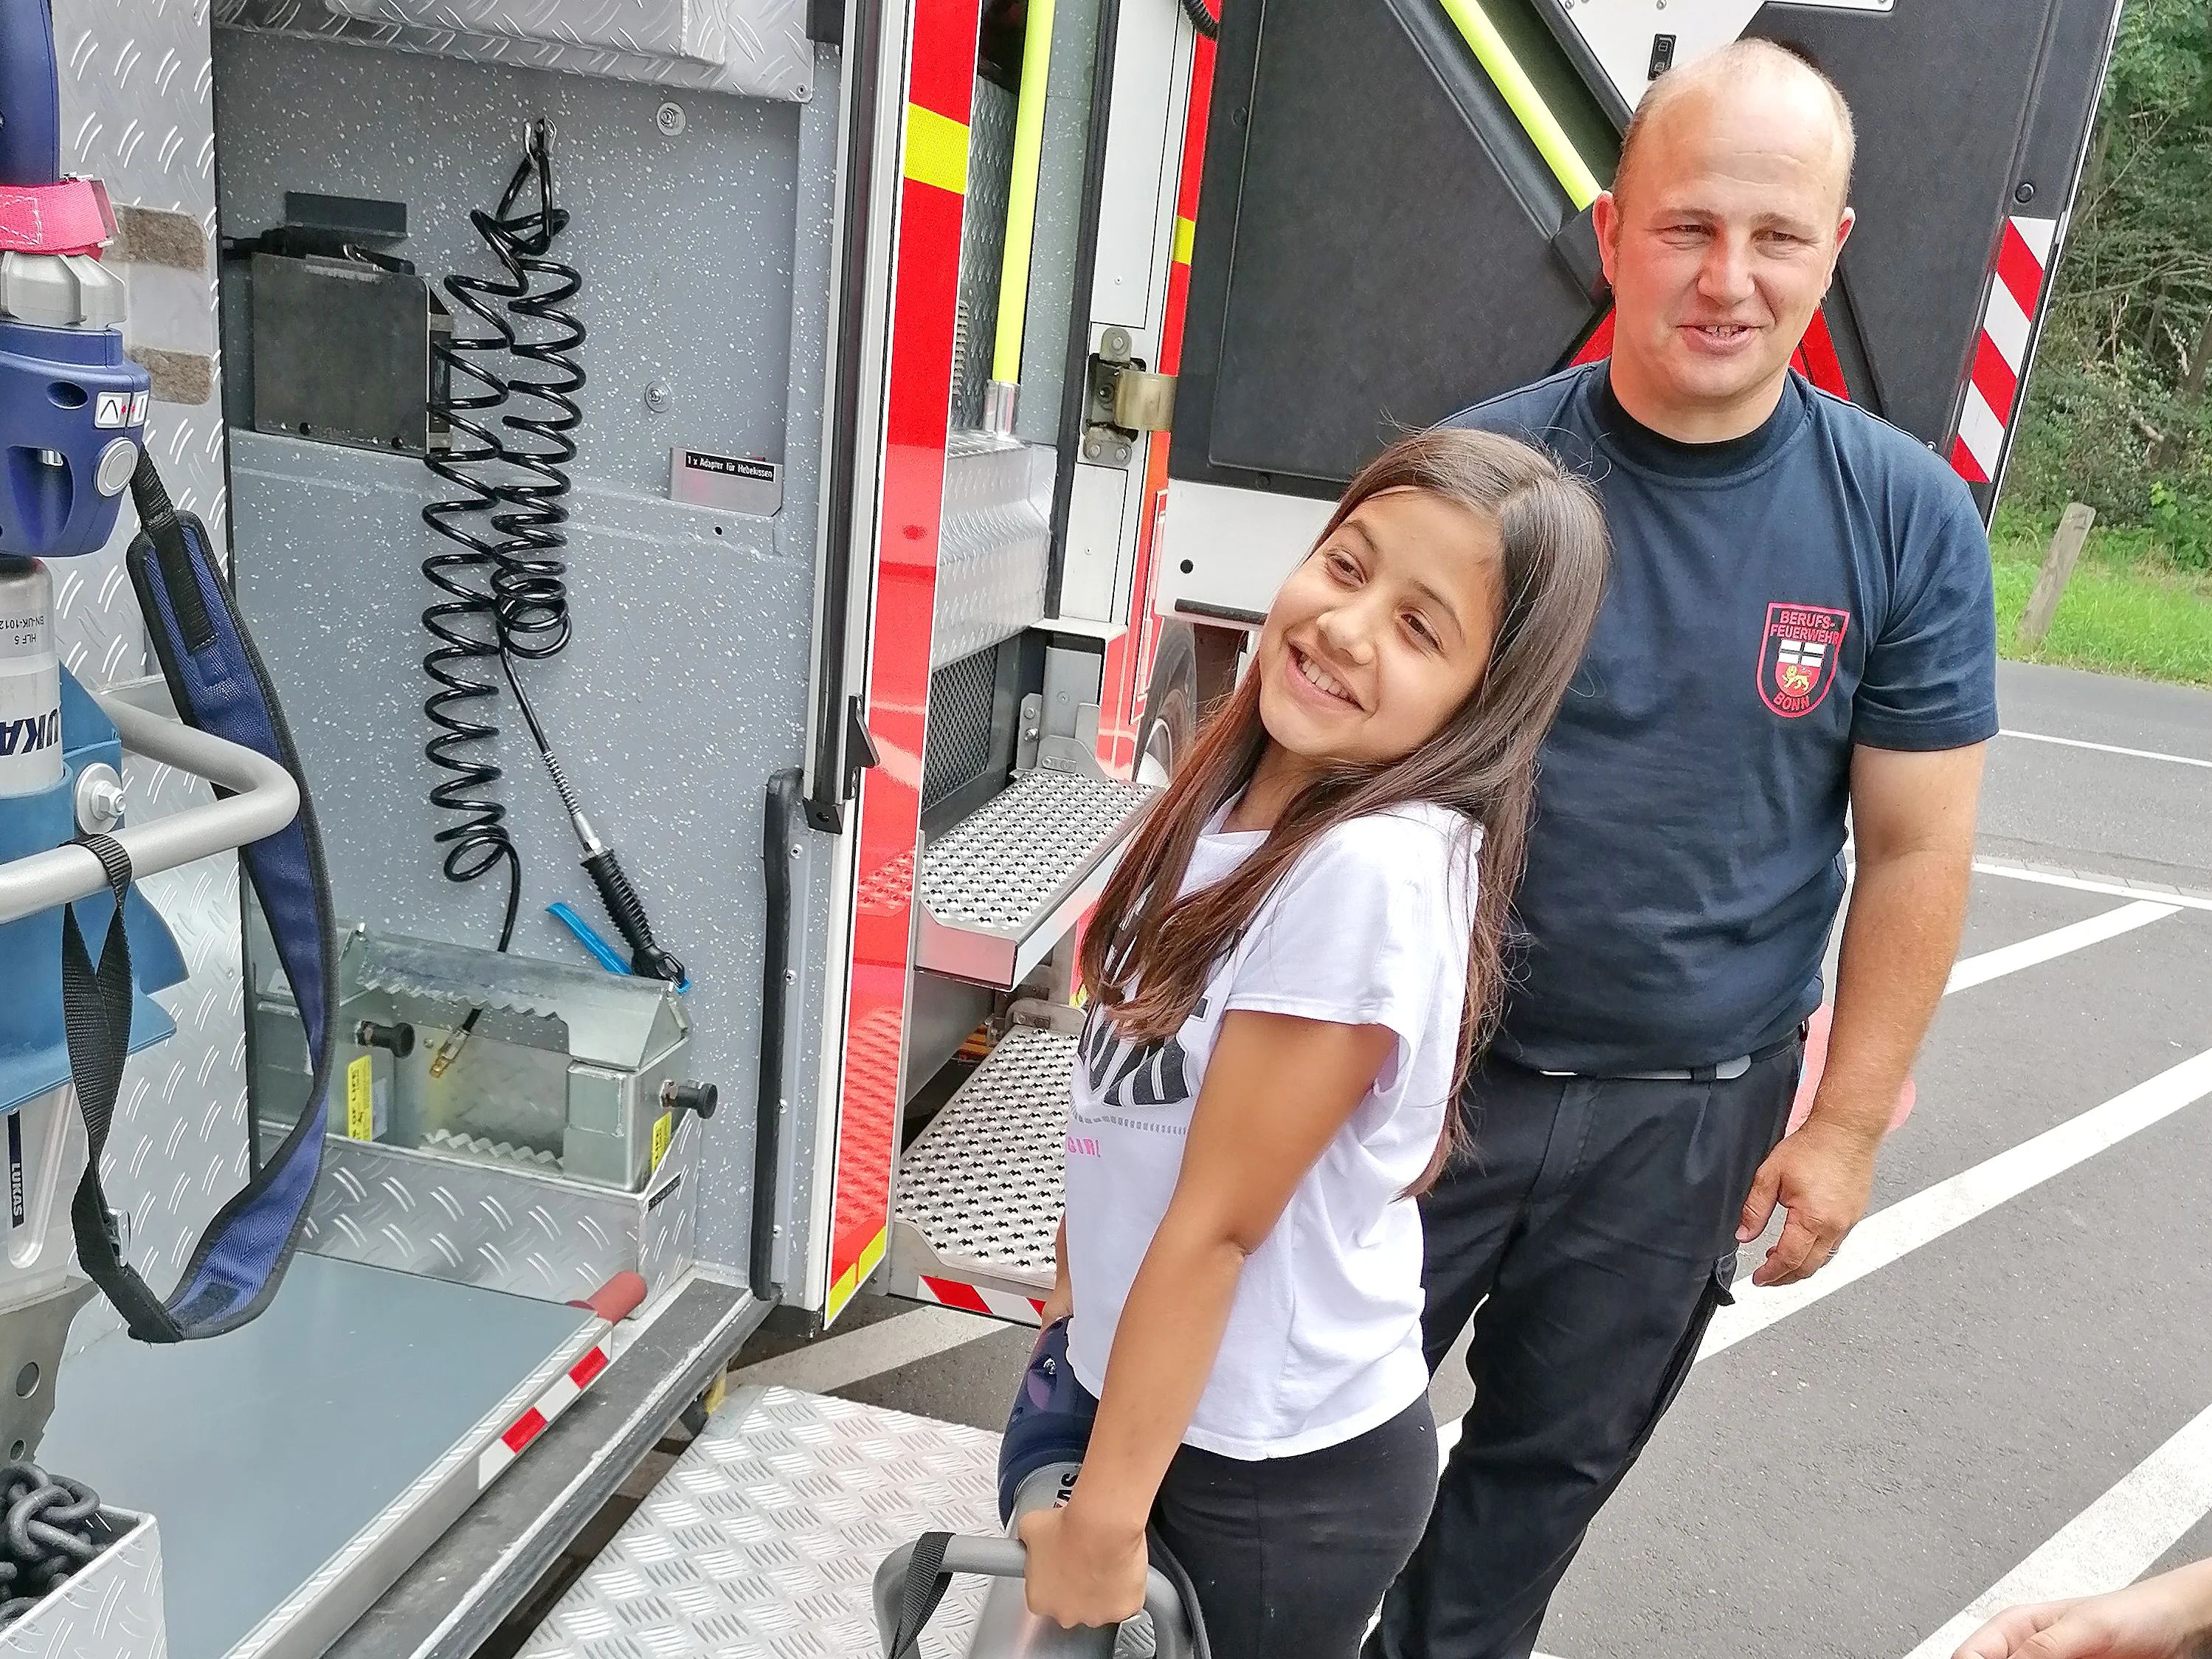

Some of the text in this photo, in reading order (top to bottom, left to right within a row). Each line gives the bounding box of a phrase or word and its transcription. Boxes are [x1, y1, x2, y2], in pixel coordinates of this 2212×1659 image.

[1780, 610, 1836, 630] BERUFS-
[22, 633, 36, 644] HLF
[1769, 624, 1842, 645] FEUERWEHR
[1773, 691, 1810, 711] BONN
[11, 1162, 23, 1218] LUKAS
